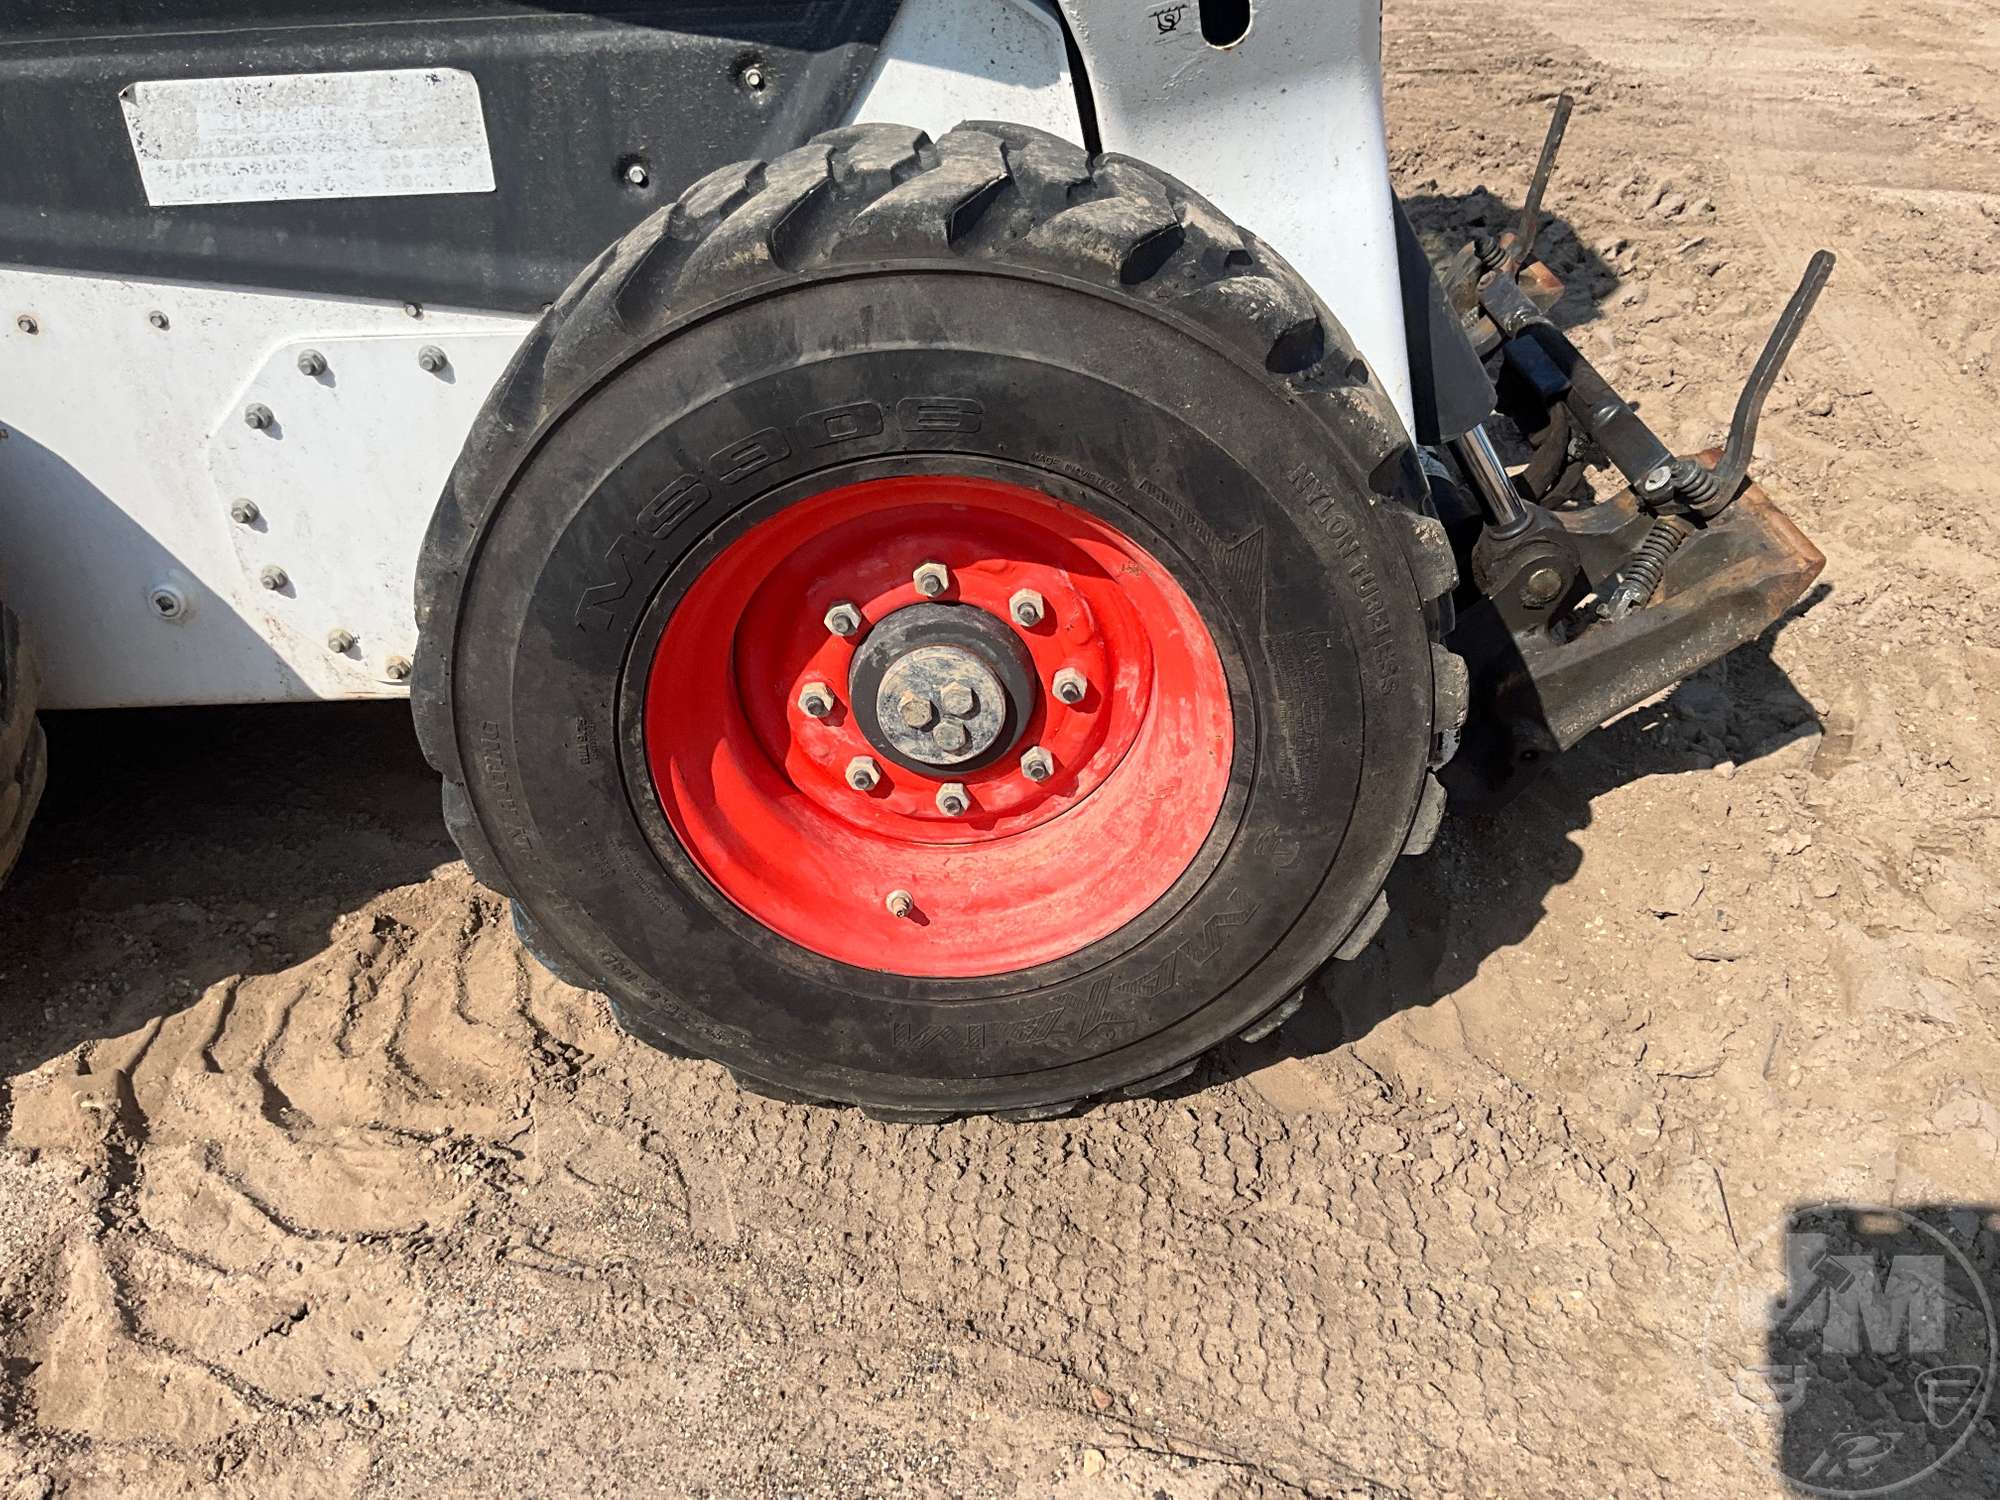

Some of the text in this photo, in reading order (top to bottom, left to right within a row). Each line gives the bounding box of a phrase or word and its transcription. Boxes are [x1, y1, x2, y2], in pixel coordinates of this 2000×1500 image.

[1287, 461, 1361, 560] NYLON
[1349, 554, 1399, 696] TUBELESS
[891, 886, 1262, 1051] MAXAM
